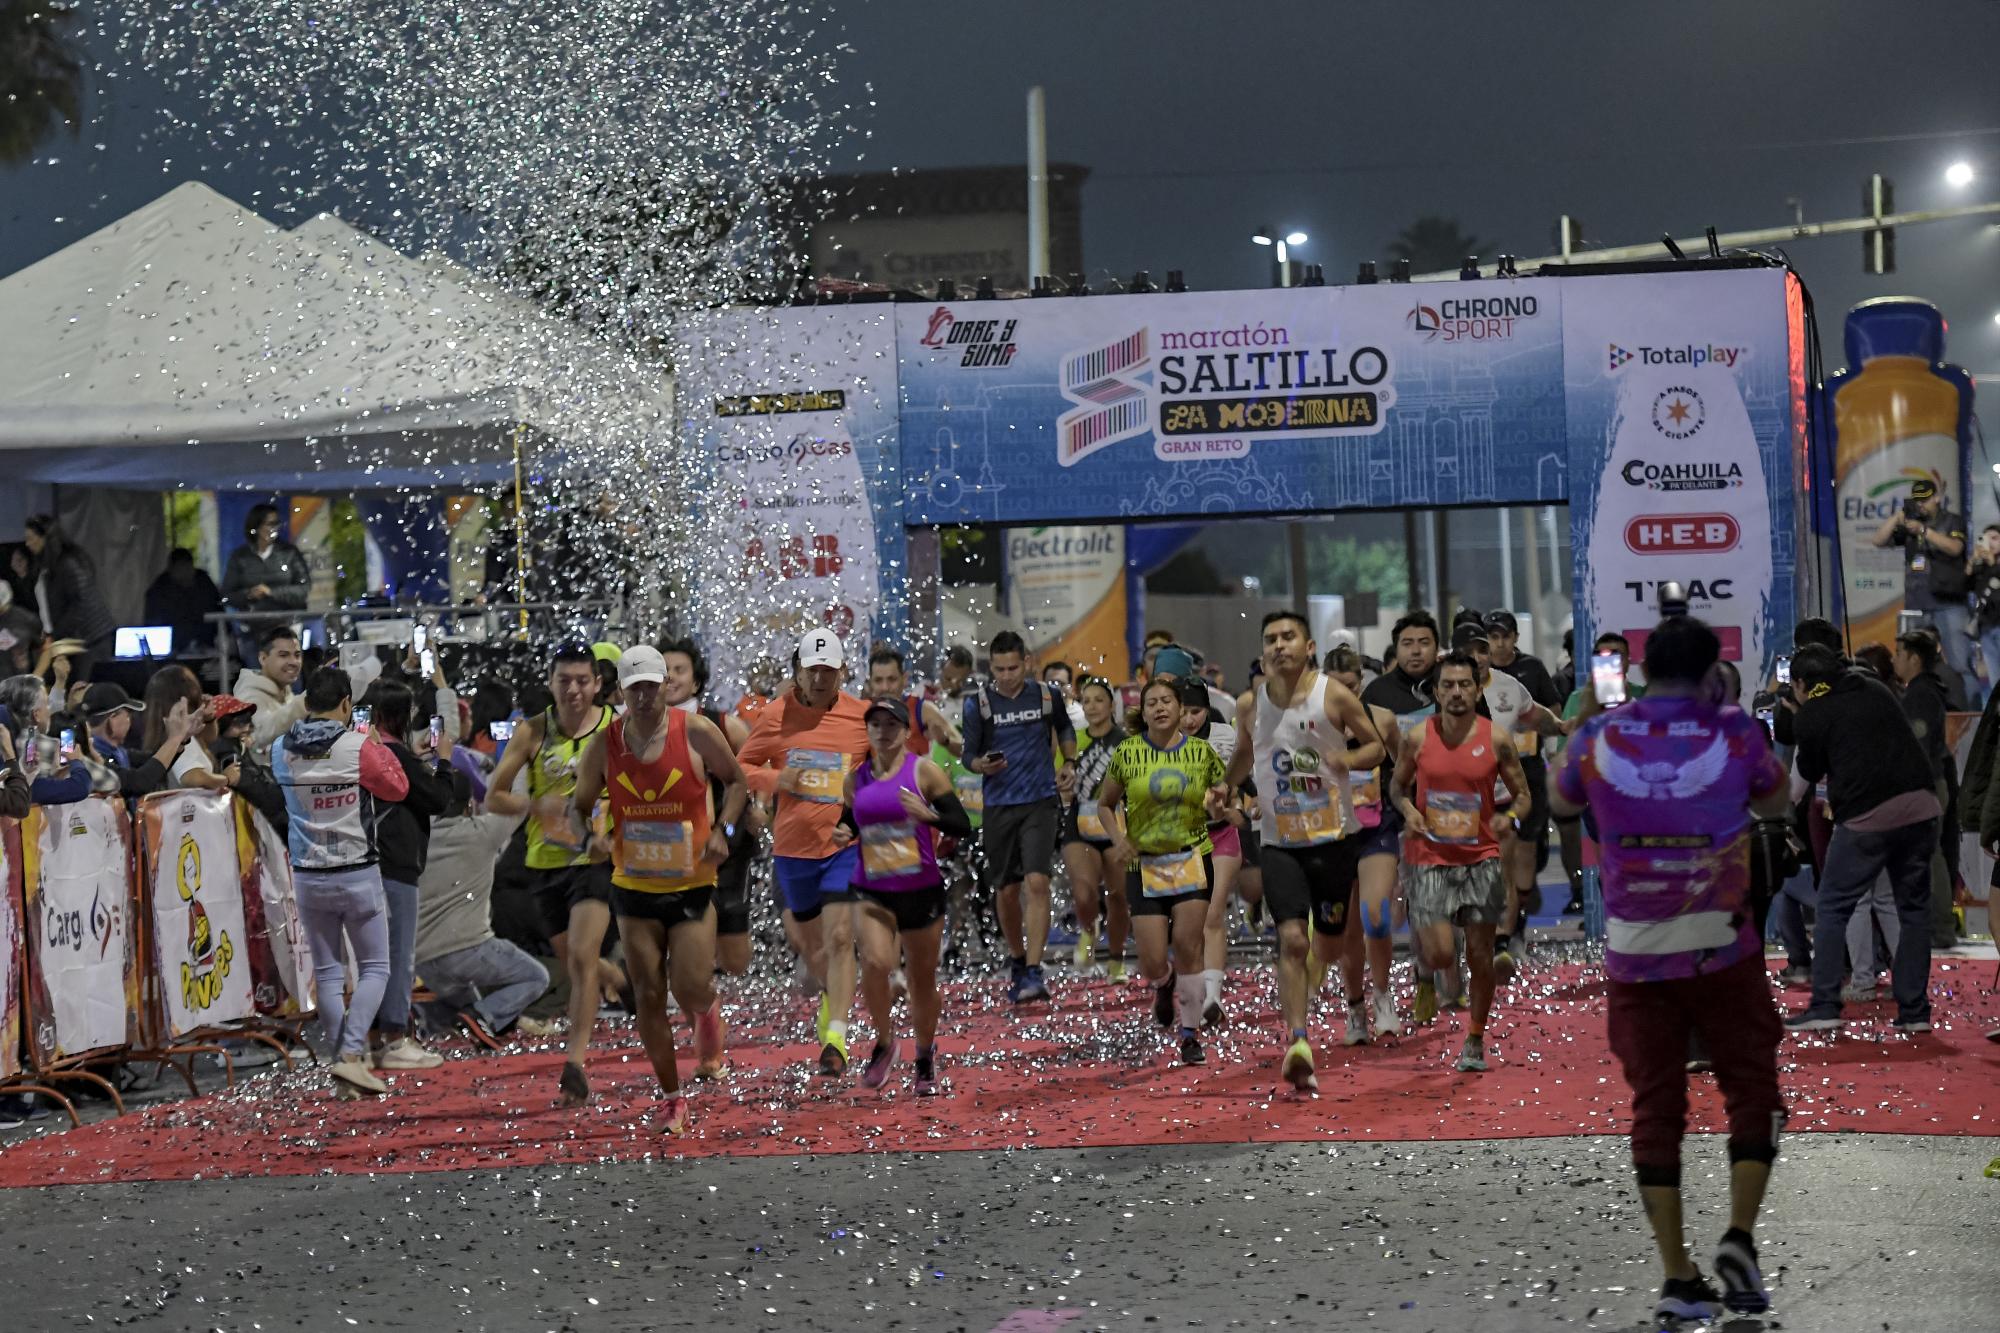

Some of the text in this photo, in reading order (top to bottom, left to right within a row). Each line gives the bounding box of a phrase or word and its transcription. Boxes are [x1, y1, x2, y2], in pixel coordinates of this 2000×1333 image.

[1441, 296, 1537, 318] CHRONO
[920, 306, 1017, 346] CORRE Y
[1161, 321, 1289, 350] maratón
[1443, 317, 1515, 341] SPORT
[1638, 344, 1739, 368] Totalplay
[1160, 346, 1388, 394] SALTILLO
[1667, 386, 1699, 399] PASOS
[1165, 397, 1373, 431] LA MODERNA
[1161, 439, 1244, 455] GRAN RETO
[1621, 459, 1743, 486] COAHUILA
[1683, 480, 1718, 490] DELANTE
[815, 638, 826, 652] P
[313, 792, 357, 810] RETO
[622, 802, 683, 816] MARATHON
[635, 844, 673, 861] 333
